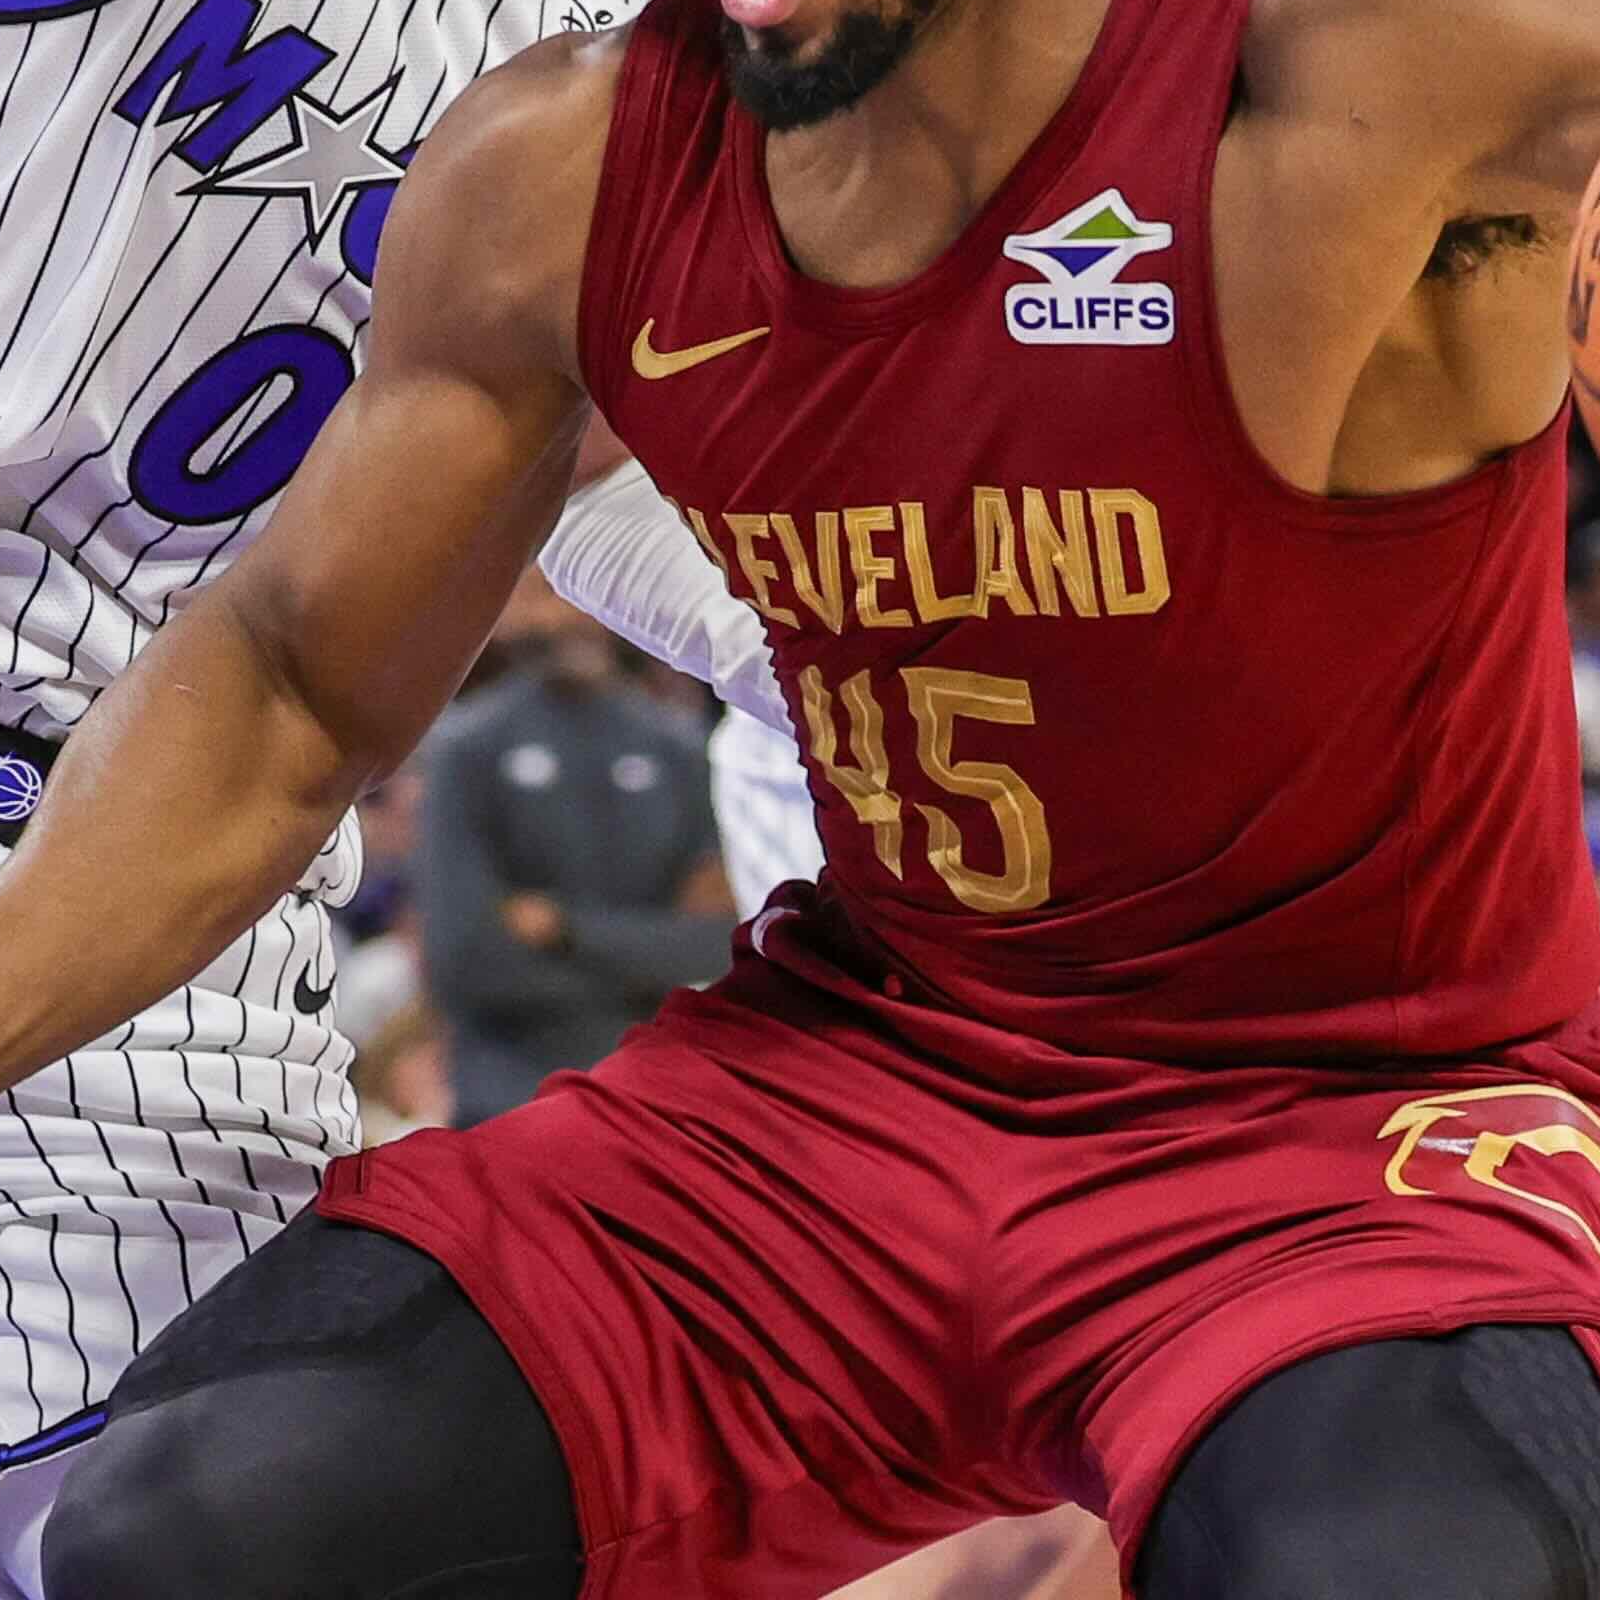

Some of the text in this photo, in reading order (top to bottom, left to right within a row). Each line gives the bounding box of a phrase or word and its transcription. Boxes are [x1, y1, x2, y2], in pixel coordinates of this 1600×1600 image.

[1012, 296, 1171, 333] CLIFFS
[664, 486, 1172, 636] LEVELAND
[800, 664, 1052, 915] 45
